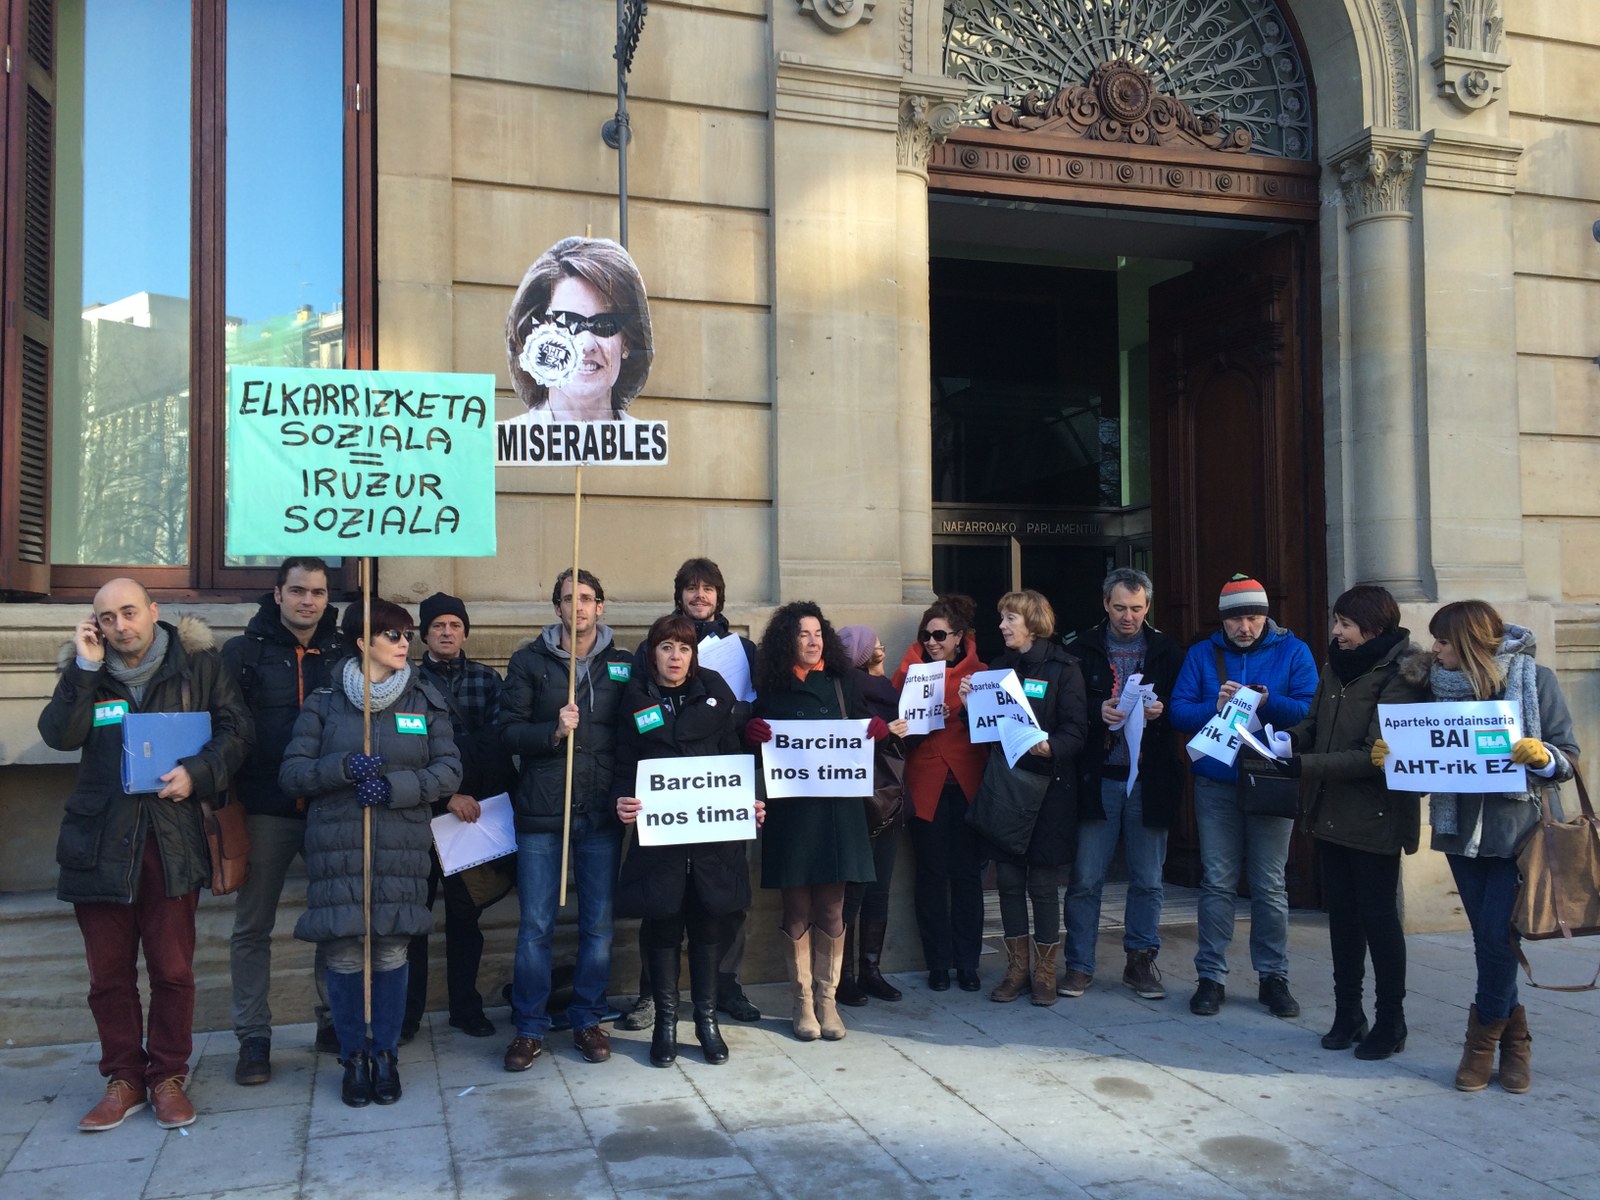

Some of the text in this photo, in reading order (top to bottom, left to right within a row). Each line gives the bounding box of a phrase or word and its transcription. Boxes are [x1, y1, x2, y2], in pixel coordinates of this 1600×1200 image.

[543, 345, 562, 357] AHT
[546, 355, 559, 365] EZ
[239, 380, 487, 428] ELKARRIZKETA
[281, 421, 452, 455] SOZIALA
[498, 423, 668, 461] MISERABLES
[302, 468, 444, 500] IRUZUR
[284, 505, 460, 539] SOZIALA
[942, 520, 1017, 533] NAFARROAKO
[609, 665, 629, 678] ELA
[1023, 682, 1044, 694] ELA
[95, 705, 125, 718] ELA
[637, 711, 660, 726] ELA
[397, 717, 424, 729] ELA
[1385, 715, 1515, 730] Aparteko ordainsaria
[775, 734, 862, 749] Barcina
[1430, 729, 1507, 748] BAI ELA
[770, 765, 867, 780] nos tima
[1394, 759, 1517, 774] AHT-rik EZ
[650, 772, 741, 791] Barcina
[646, 806, 749, 826] nos tima
